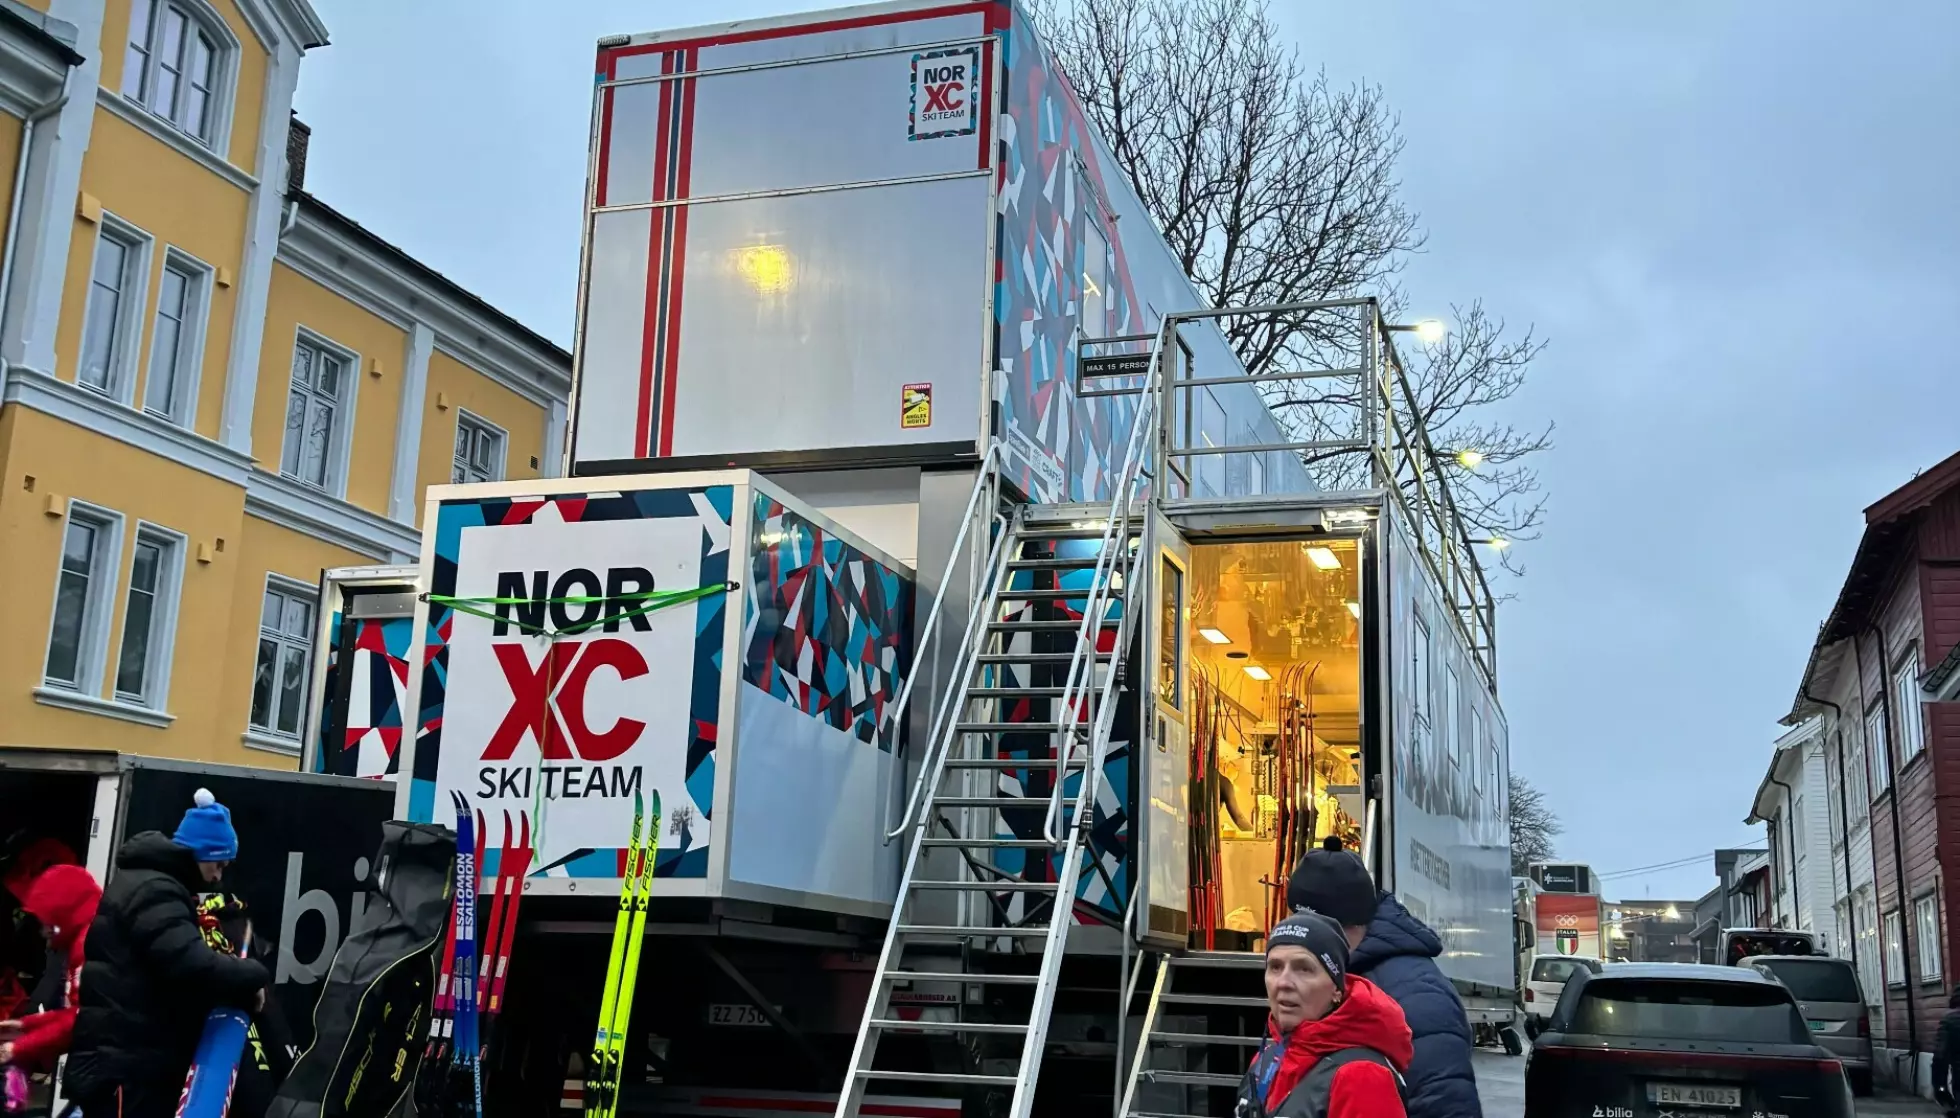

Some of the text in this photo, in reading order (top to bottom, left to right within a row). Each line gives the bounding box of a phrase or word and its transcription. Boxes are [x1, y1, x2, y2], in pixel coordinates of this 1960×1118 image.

[924, 65, 965, 84] NOR
[922, 82, 965, 113] XC
[922, 110, 965, 122] SKI TEAM
[1086, 364, 1104, 372] MAX
[491, 566, 656, 637] NOR
[480, 638, 650, 762] XC
[476, 765, 643, 799] SKI TEAM
[624, 813, 644, 892] FISCHER
[641, 813, 661, 892] FISCHER
[456, 853, 465, 927] SALOMON
[465, 853, 474, 927] SALOMON
[1321, 952, 1340, 976] Swix
[714, 1006, 732, 1023] ZZ
[473, 1055, 483, 1113] SALOMON
[1661, 1086, 1737, 1105] EN 41025
[1606, 1106, 1633, 1118] bilia
